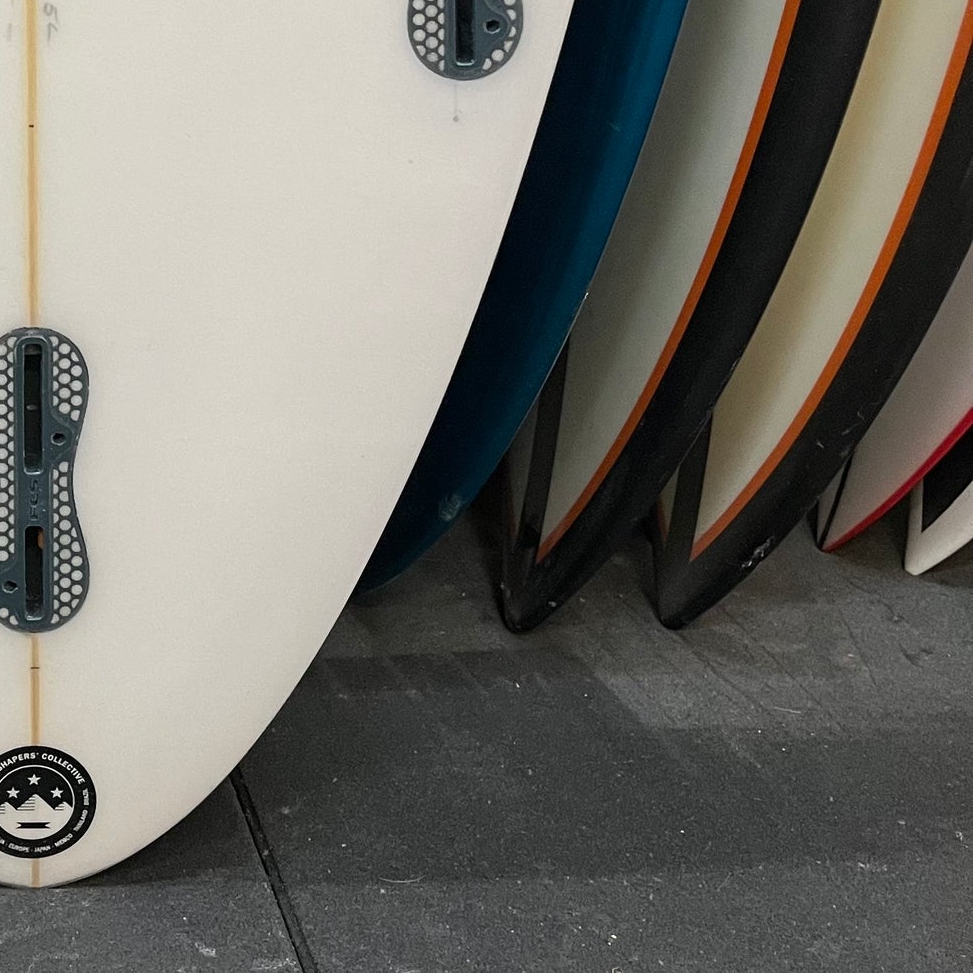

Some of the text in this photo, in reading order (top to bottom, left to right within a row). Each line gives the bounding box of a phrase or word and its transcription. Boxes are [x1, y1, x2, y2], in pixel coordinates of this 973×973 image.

[28, 477, 40, 522] FCS
[41, 752, 85, 785] COLLECTIVE
[33, 844, 51, 853] JAPAN
